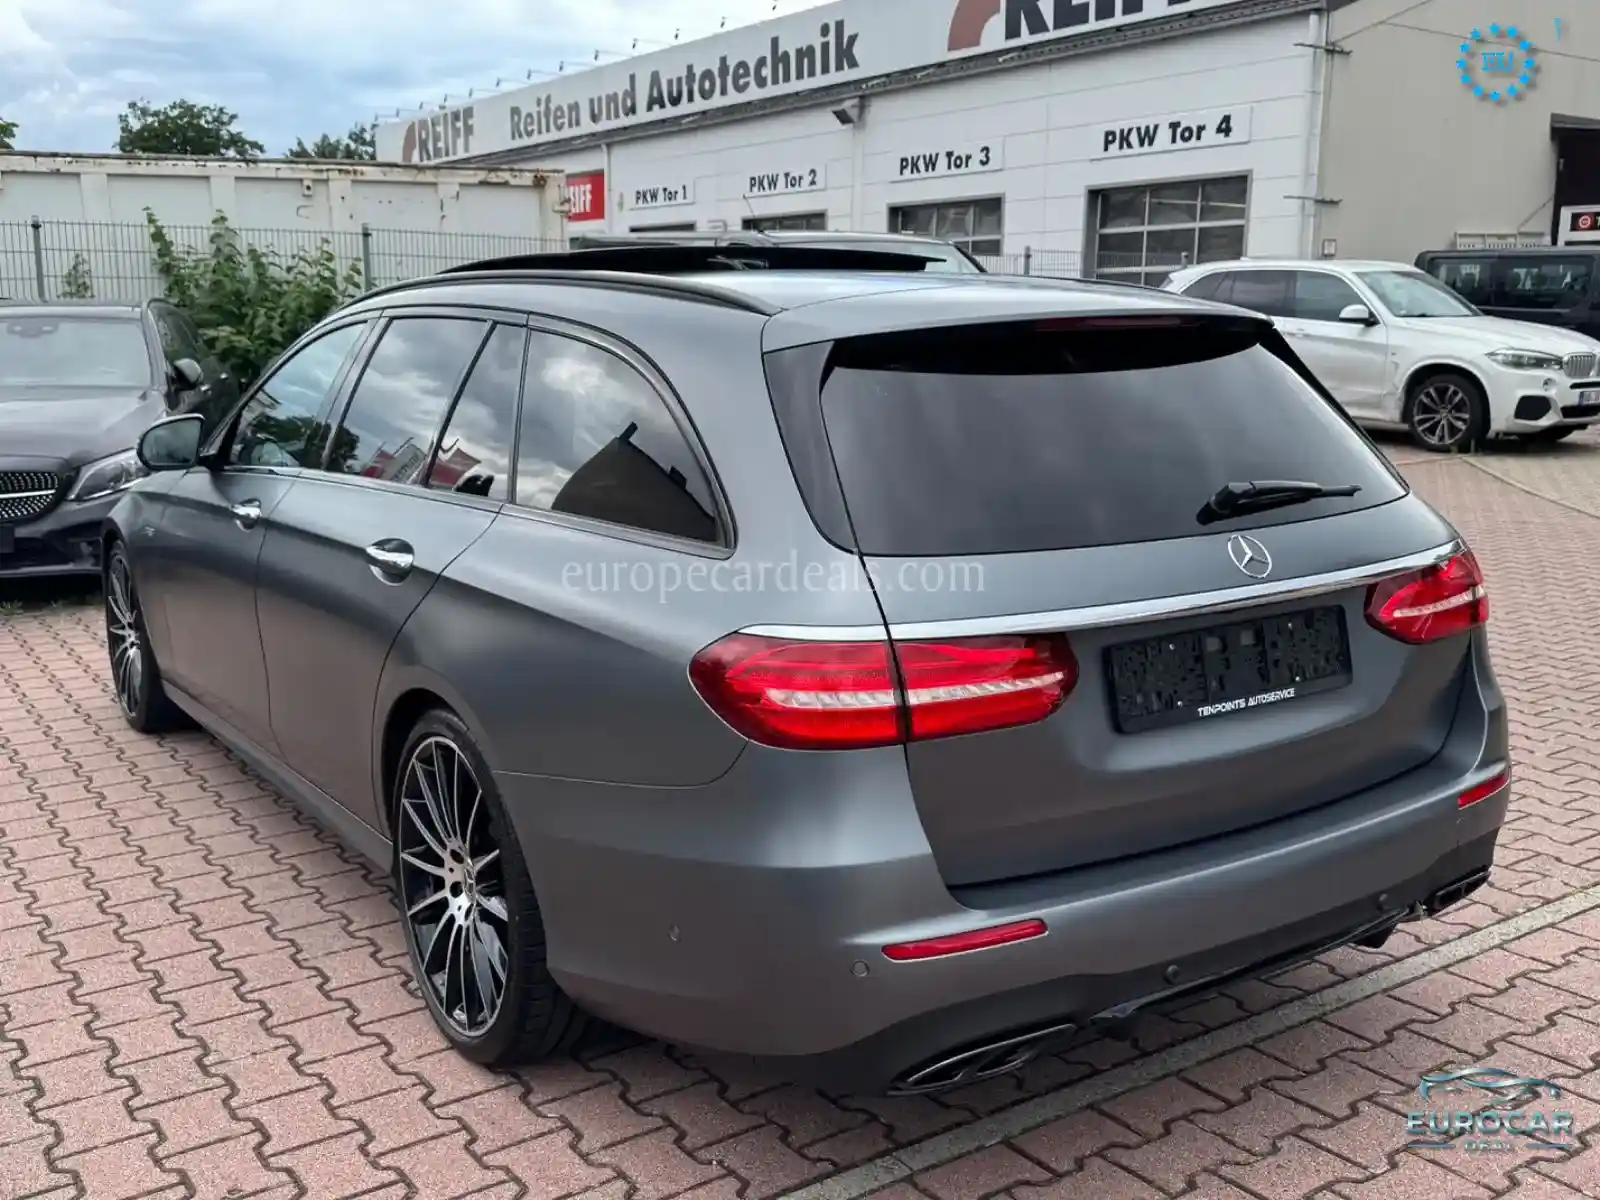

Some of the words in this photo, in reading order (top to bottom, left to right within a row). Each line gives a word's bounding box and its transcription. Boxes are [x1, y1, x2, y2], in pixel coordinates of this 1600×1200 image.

[510, 93, 581, 141] Reifen
[588, 73, 637, 124] und
[645, 19, 860, 112] Autotechnik
[417, 106, 474, 162] REIFF
[1103, 123, 1160, 152] PKW
[1168, 120, 1206, 145] Tor
[1215, 114, 1232, 138] 4
[899, 152, 940, 176] PKW
[945, 150, 972, 170] Tor
[979, 146, 991, 166] 3
[635, 187, 660, 205] PKW
[662, 187, 679, 202] Tor
[682, 184, 688, 200] 1
[749, 173, 780, 193] PKW
[783, 171, 804, 189] Tor
[808, 168, 817, 187] 2
[568, 183, 592, 213] EIFF
[1198, 698, 1246, 717] TENPOINTS
[1247, 687, 1296, 707] AUTOSERVICE
